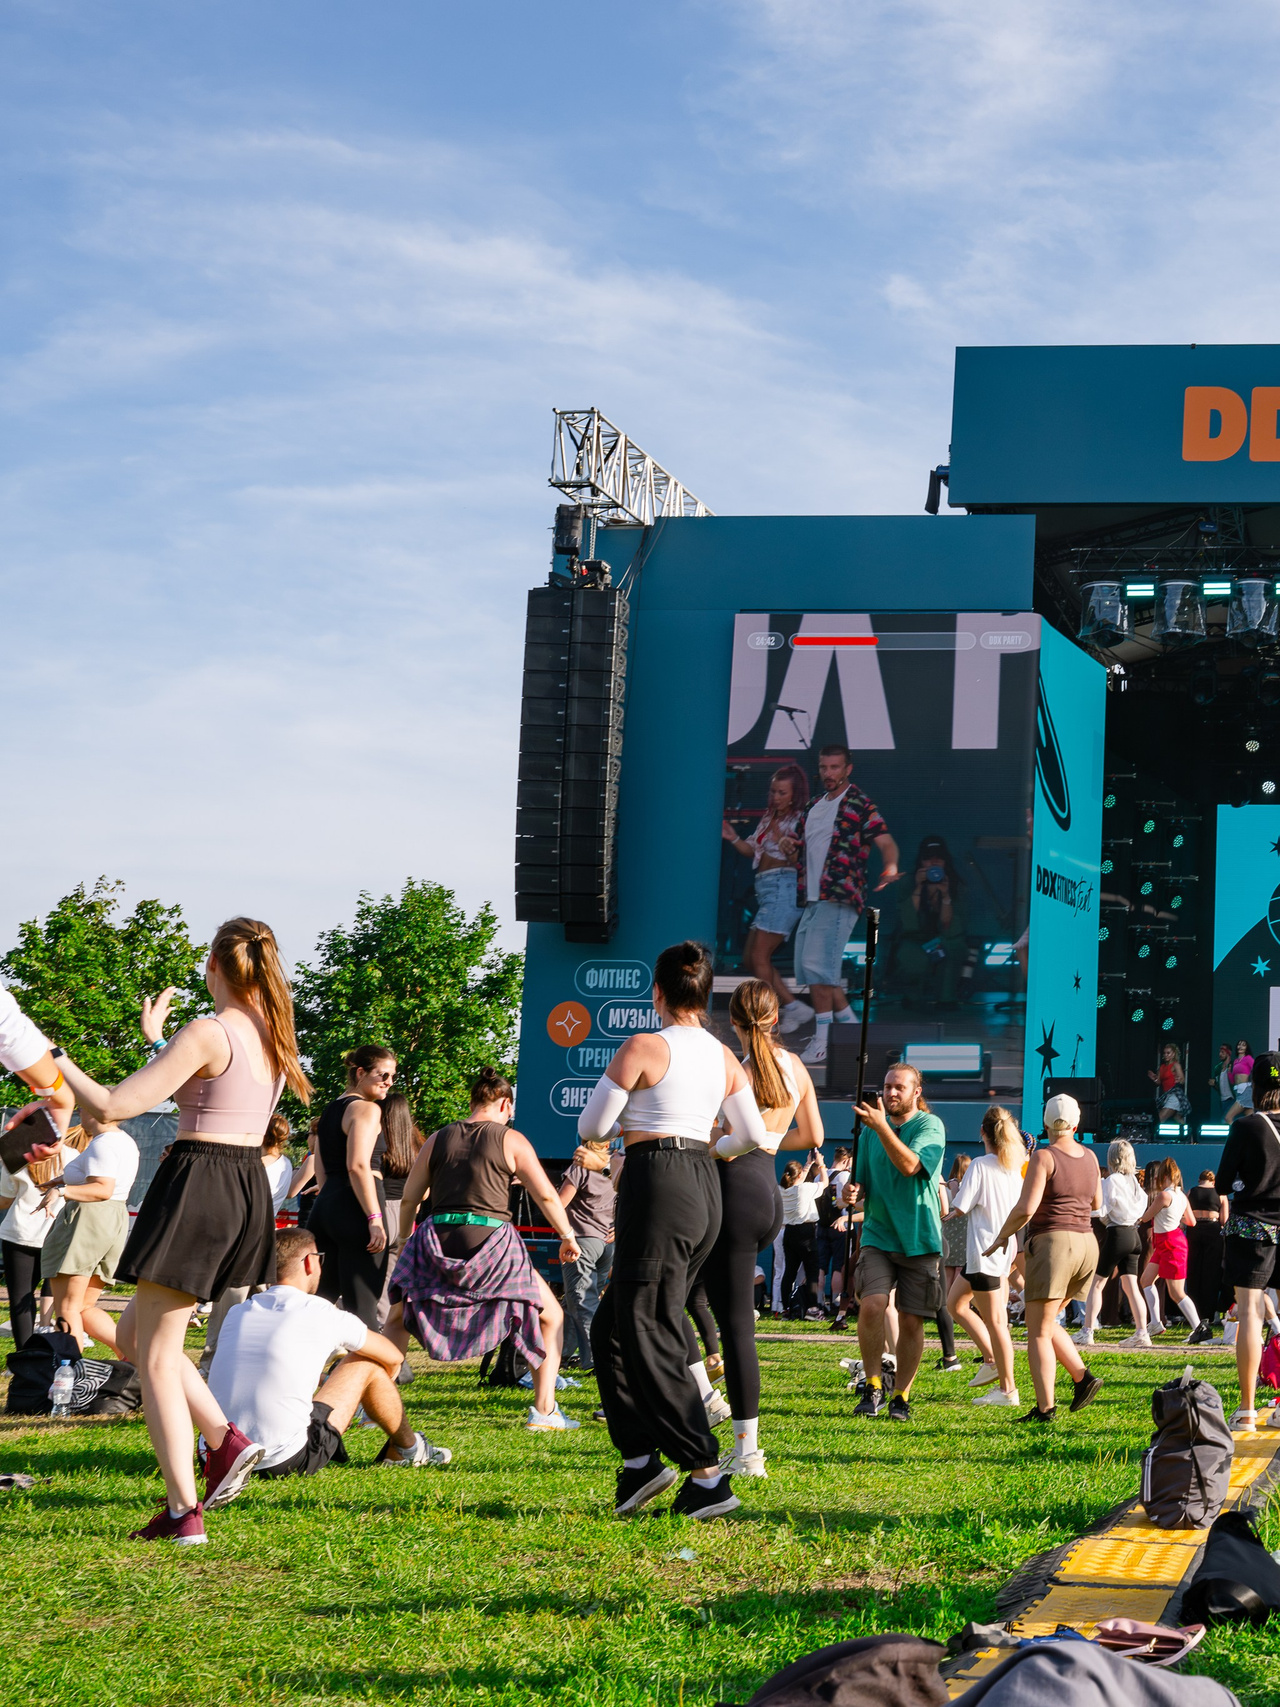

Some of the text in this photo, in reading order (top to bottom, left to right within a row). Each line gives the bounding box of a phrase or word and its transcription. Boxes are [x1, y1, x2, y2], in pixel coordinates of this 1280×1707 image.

[1002, 635, 1022, 645] PARTY
[1036, 864, 1057, 900] DDX
[584, 967, 641, 989] ФИТНЕС
[608, 1008, 663, 1029] МУЗЫК
[578, 1047, 618, 1068] ТРЕН
